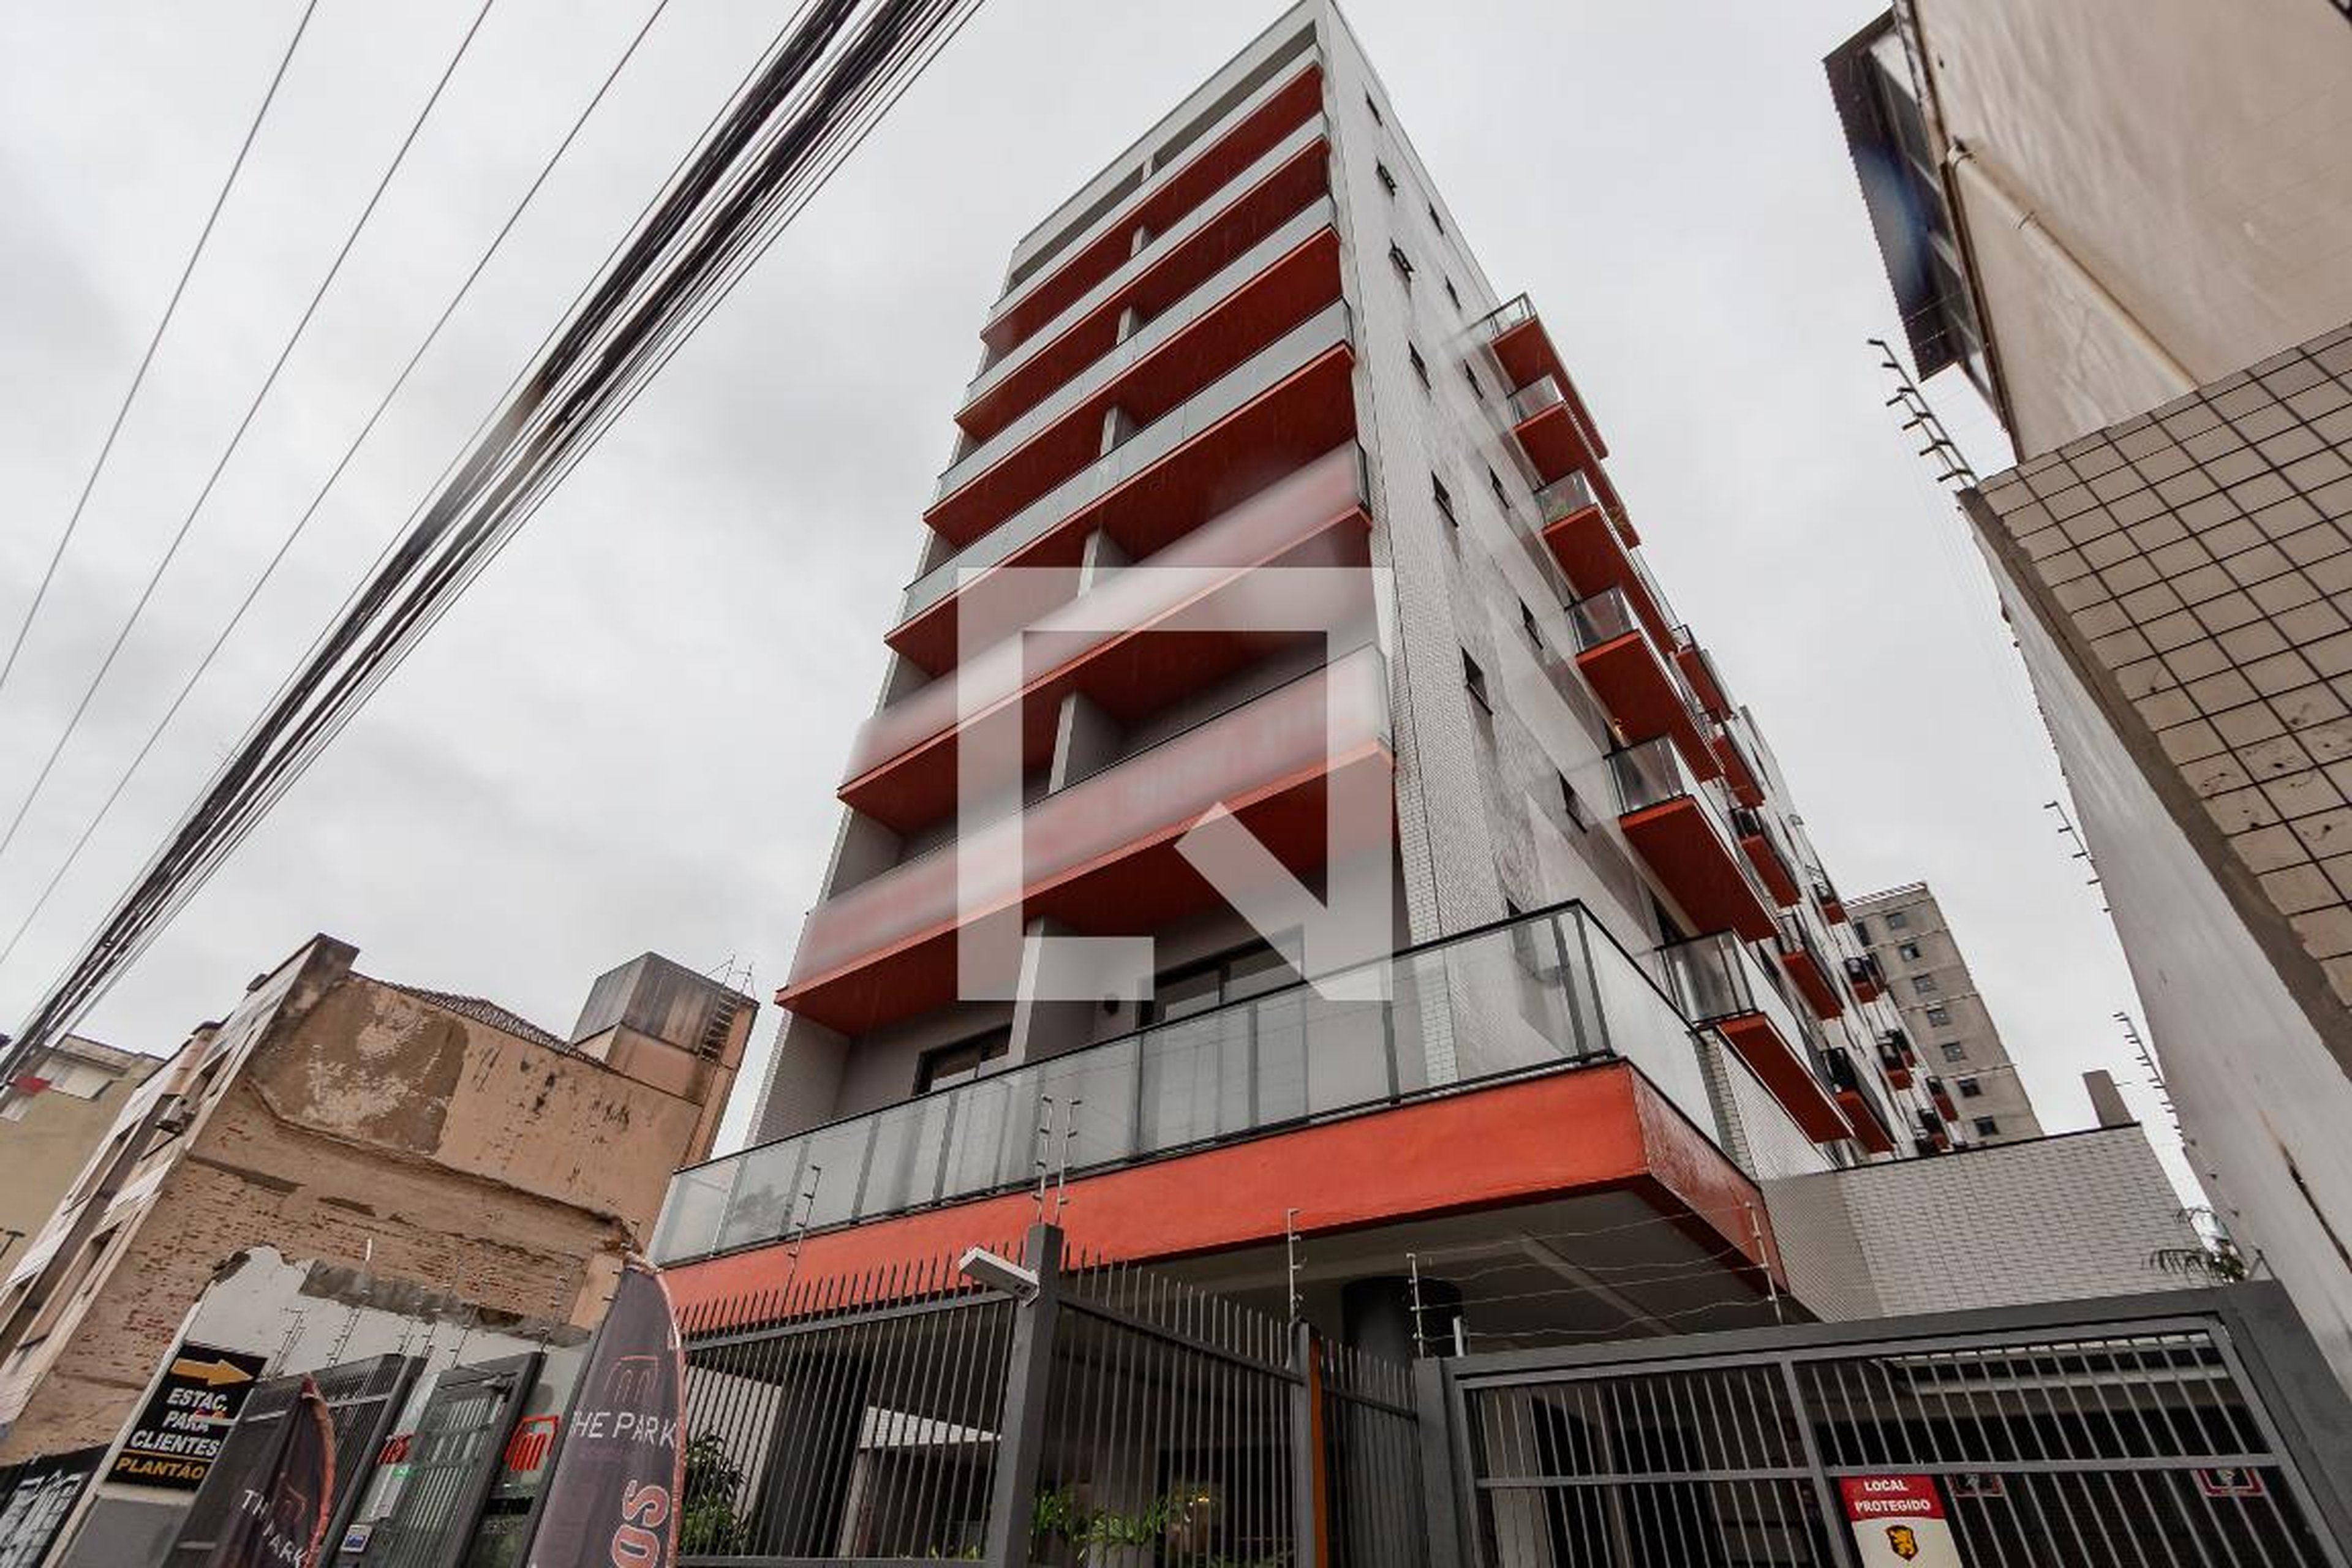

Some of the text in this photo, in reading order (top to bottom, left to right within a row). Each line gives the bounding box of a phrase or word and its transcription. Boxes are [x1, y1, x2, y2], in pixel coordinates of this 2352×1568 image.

[612, 1411, 677, 1449] PARK
[130, 1429, 221, 1457] CLIENTES
[1863, 1479, 1909, 1492] LOCAL
[1854, 1499, 1931, 1513] PROTEGIDO
